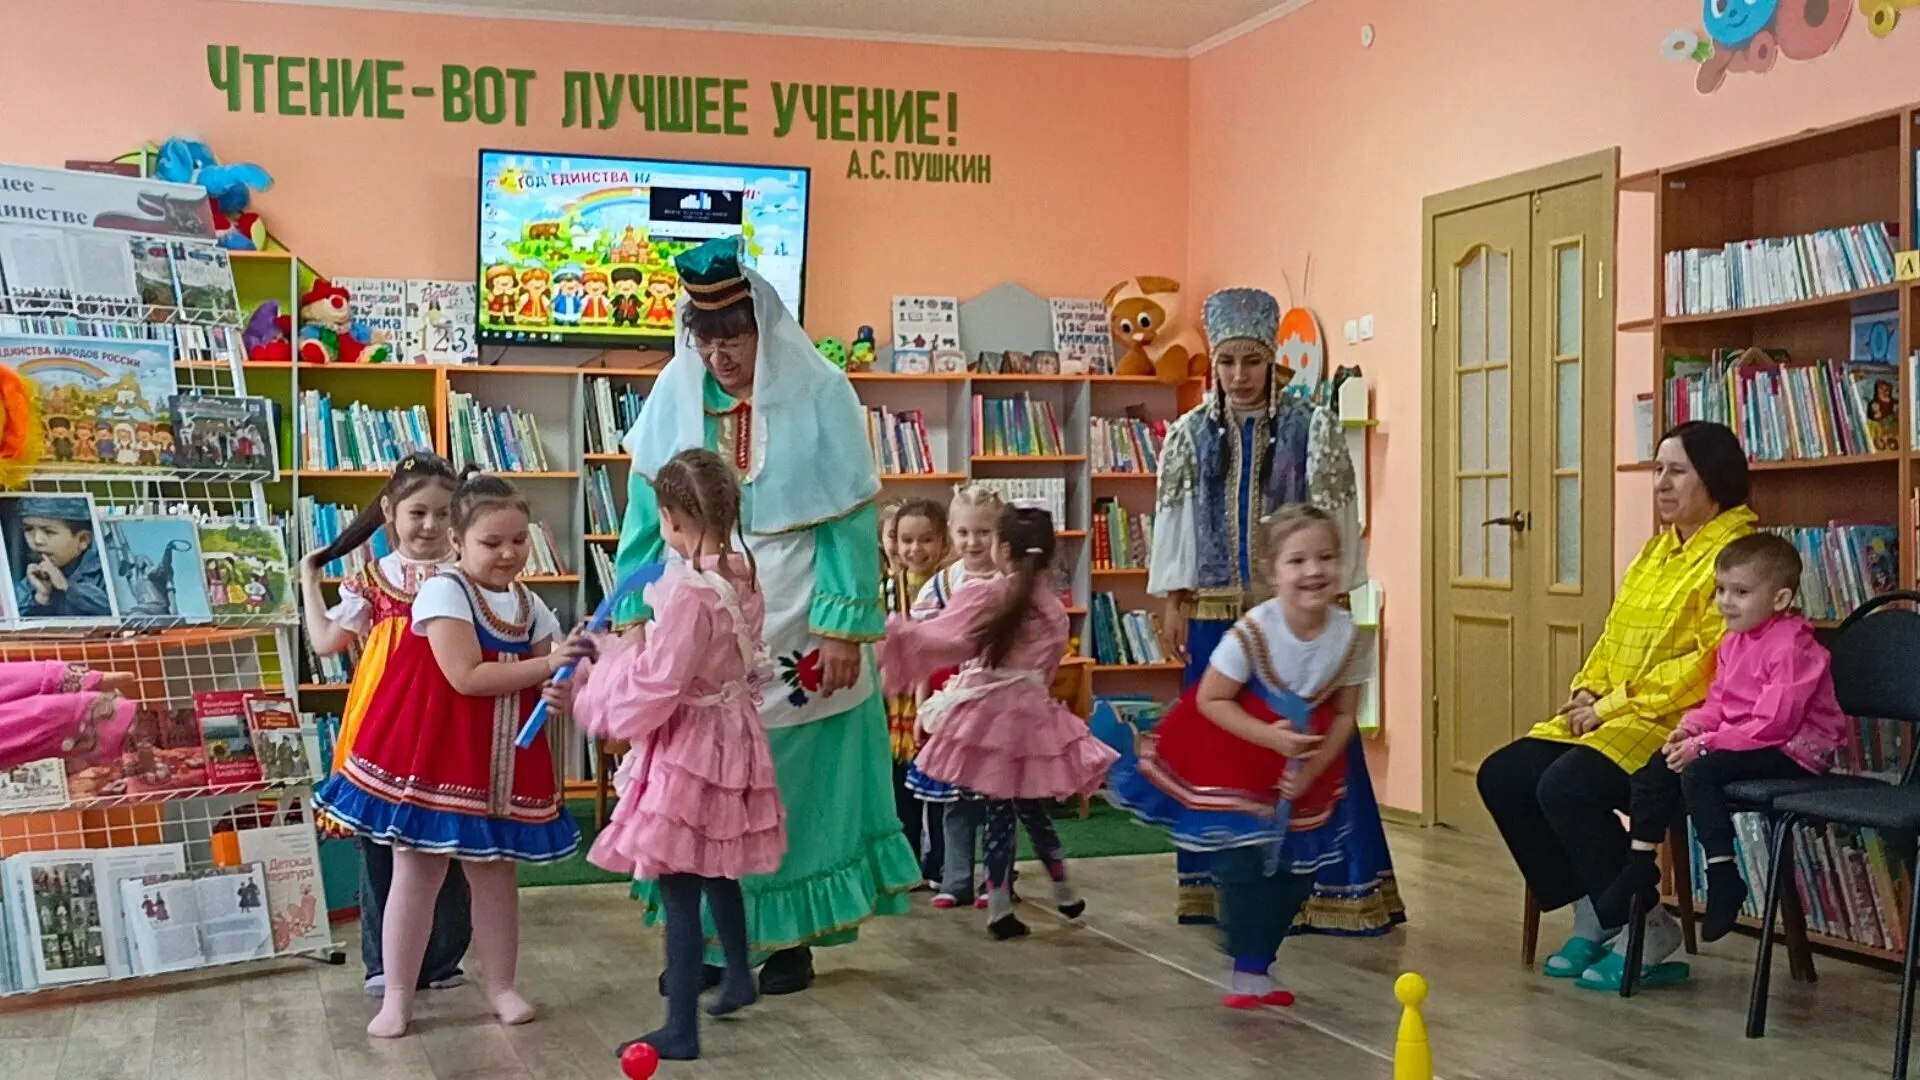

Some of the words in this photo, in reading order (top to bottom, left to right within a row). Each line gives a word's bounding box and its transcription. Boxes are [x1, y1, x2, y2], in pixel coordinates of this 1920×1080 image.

[561, 70, 749, 136] ЛУЧШЕЕ
[770, 81, 958, 147] УЧЕНИЕ!
[551, 171, 629, 187] ЕДИНСТВА
[0, 203, 89, 225] инстве
